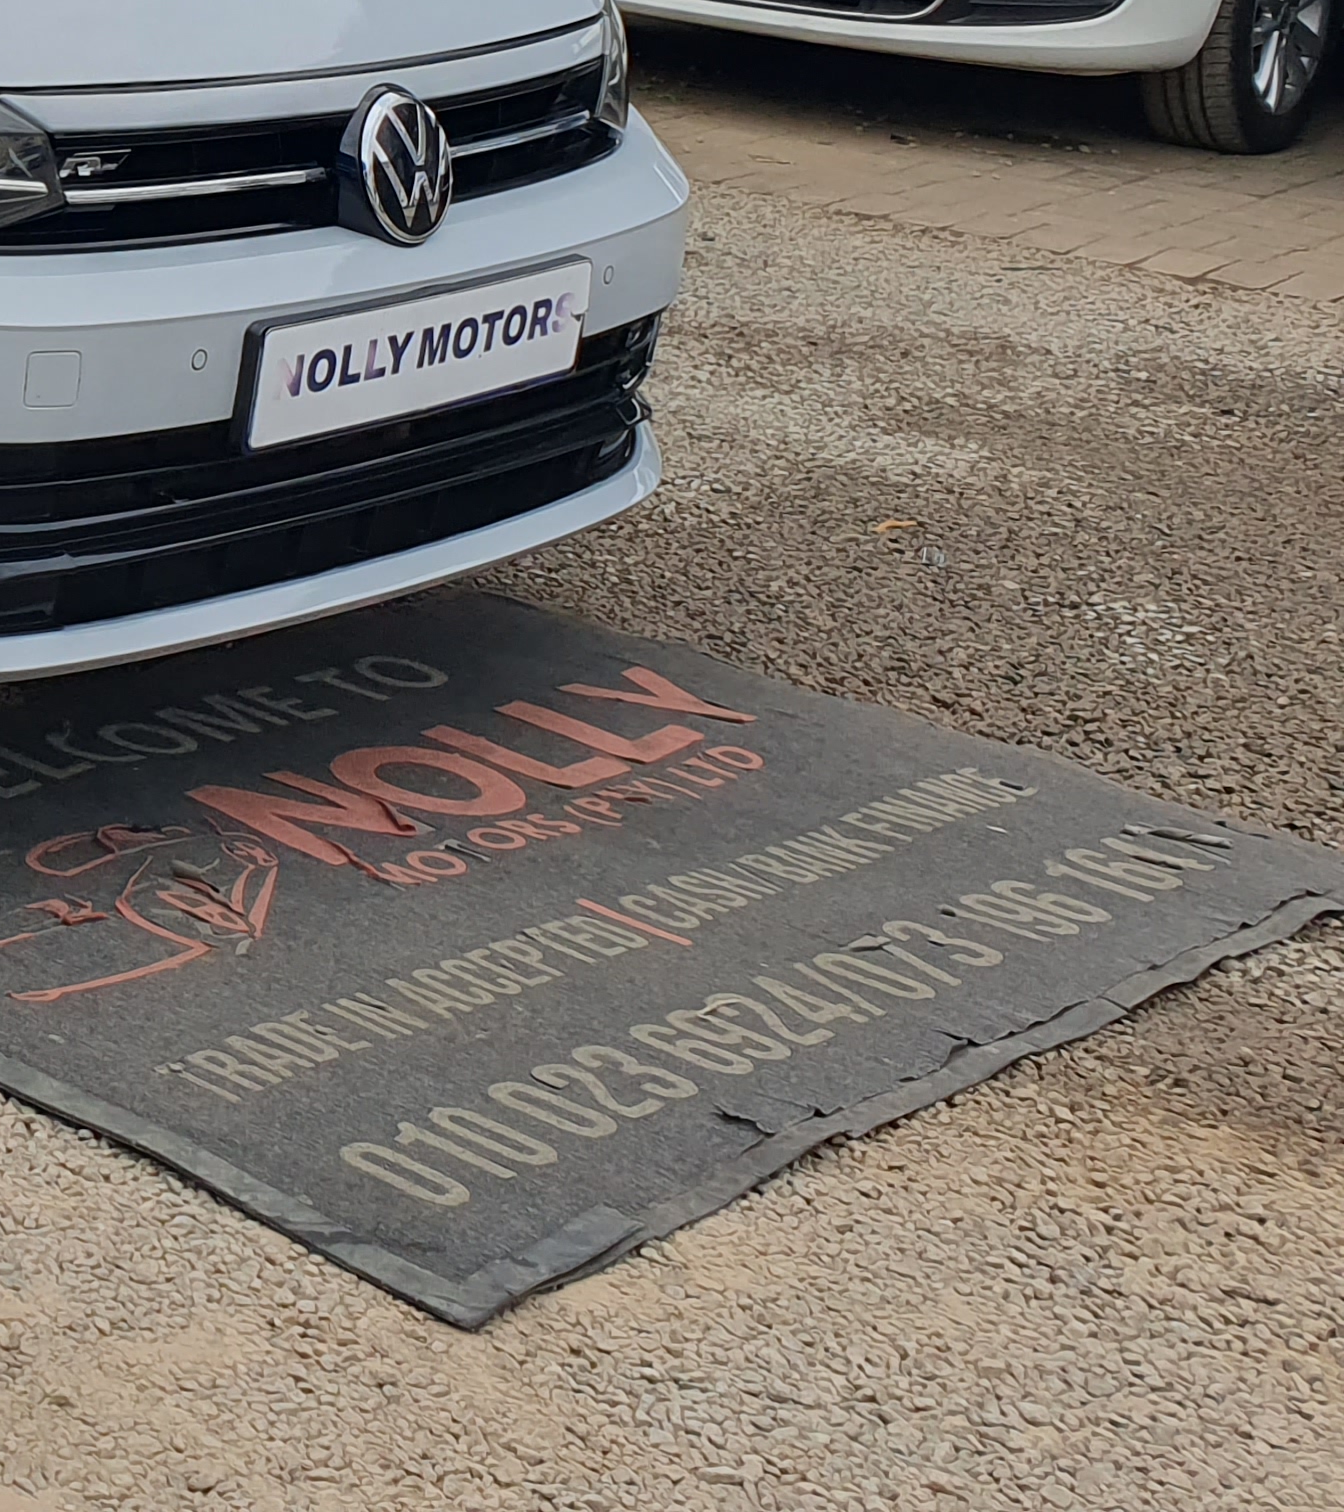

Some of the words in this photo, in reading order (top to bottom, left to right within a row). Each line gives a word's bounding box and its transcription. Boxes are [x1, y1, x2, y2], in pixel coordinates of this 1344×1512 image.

[274, 332, 414, 399] NOLLY
[416, 291, 576, 369] MOTORS
[295, 654, 449, 701] TO
[186, 666, 758, 866] NOLLY
[374, 812, 582, 888] MOTORS
[666, 744, 765, 788] LTD
[154, 1009, 374, 1103] TRADE
[321, 992, 430, 1040] IN
[385, 913, 649, 1019] ACCEPTED
[839, 767, 1040, 843] FINANCE
[338, 1106, 559, 1206] 010
[487, 1044, 700, 1138] 023
[941, 879, 1112, 942] 196
